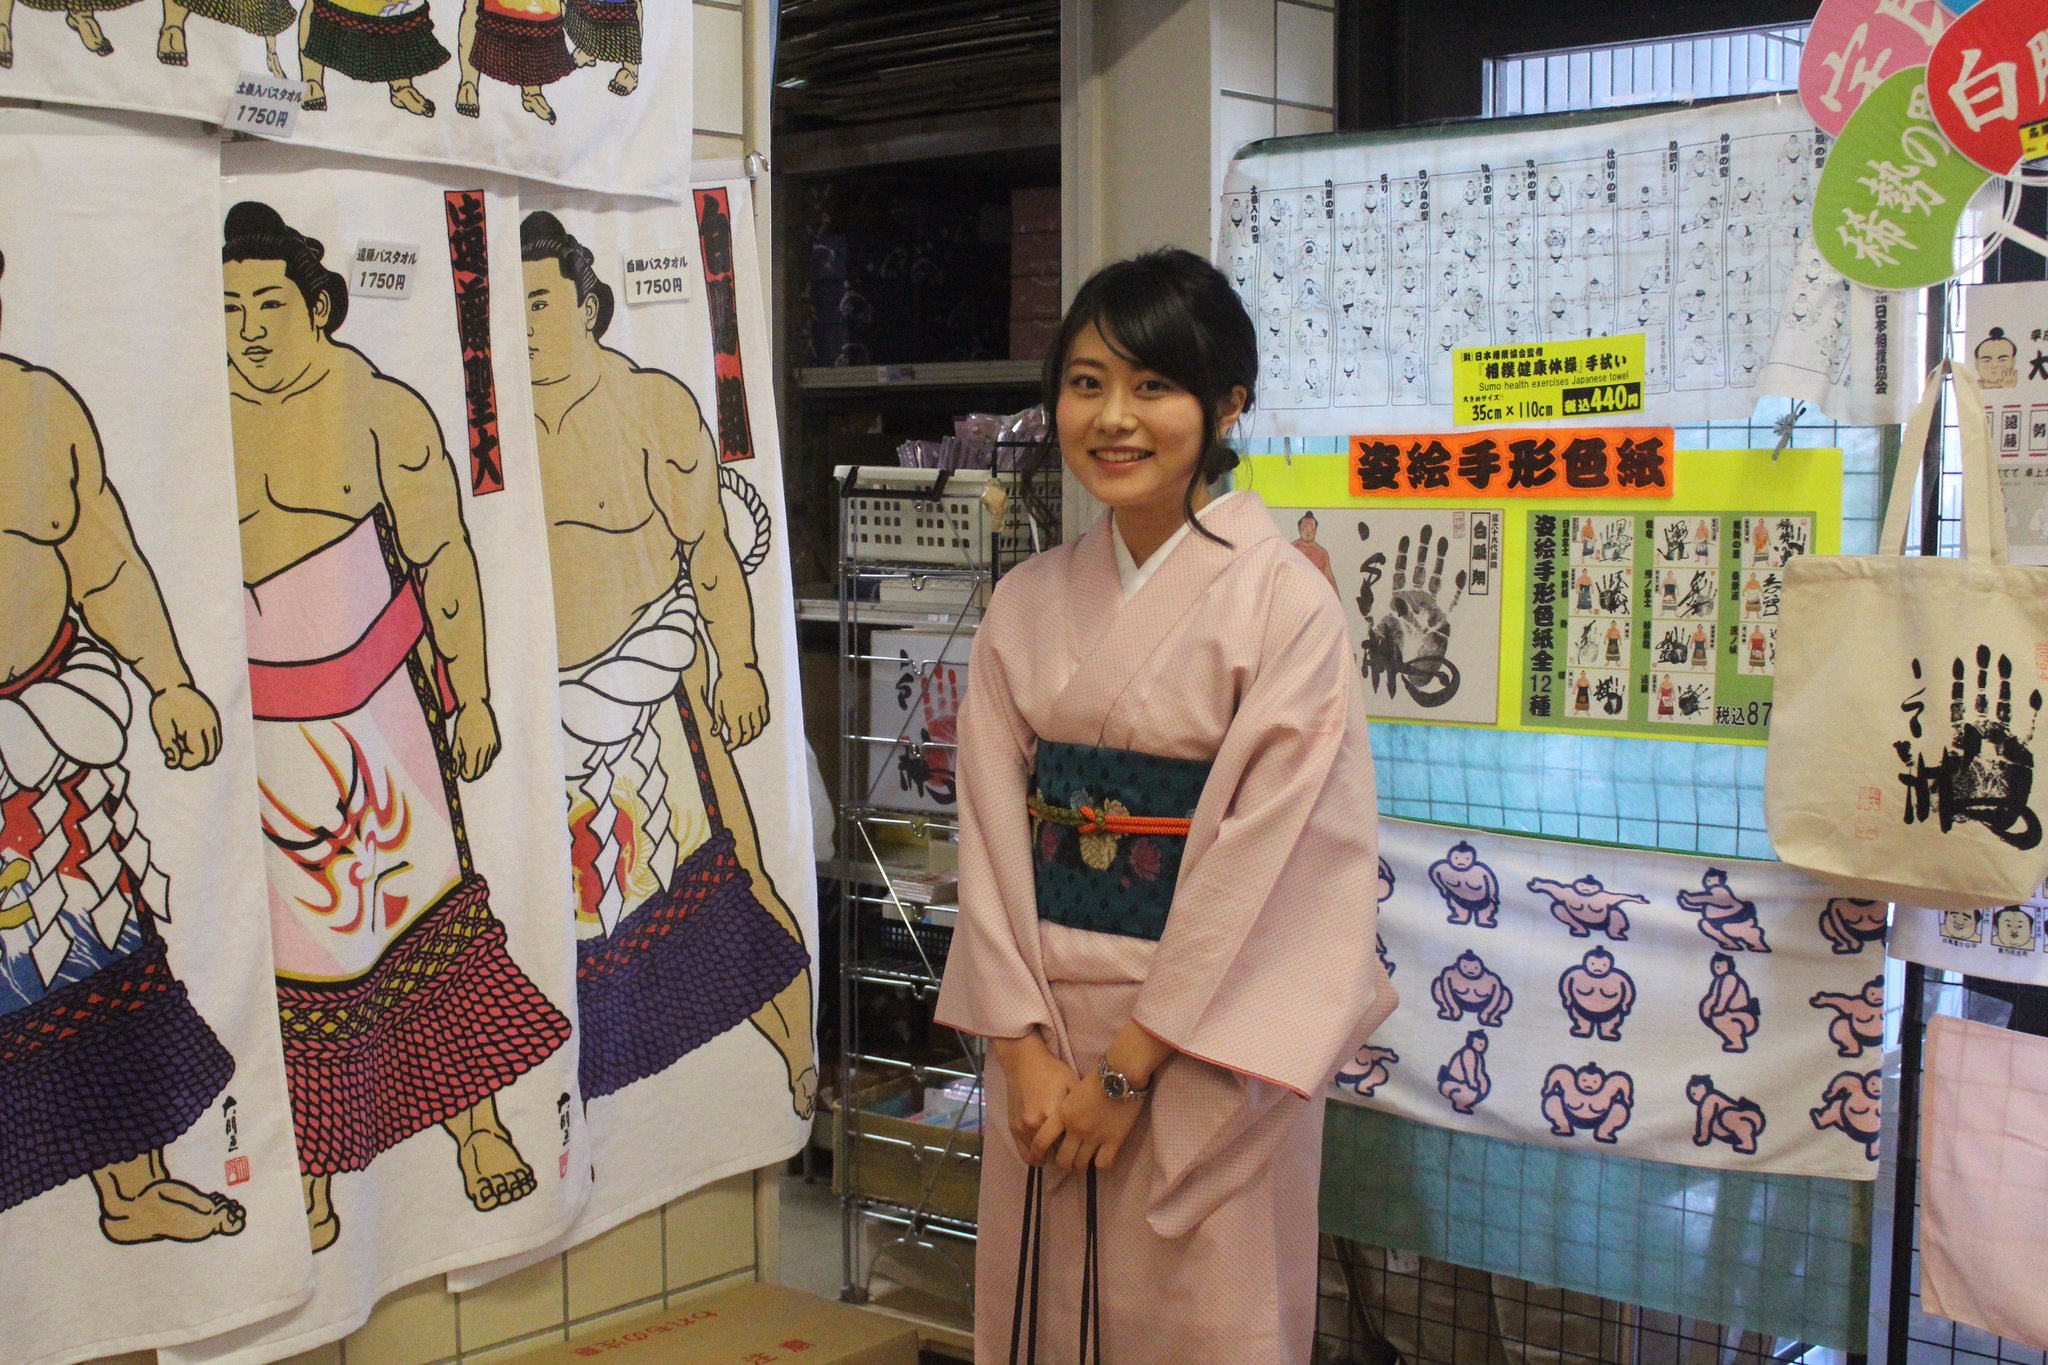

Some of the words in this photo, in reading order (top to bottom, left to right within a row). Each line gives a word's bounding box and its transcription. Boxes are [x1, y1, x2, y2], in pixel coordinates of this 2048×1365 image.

[237, 105, 289, 128] 1750円
[357, 247, 418, 265] 遠藤バスタオル
[360, 271, 406, 291] 1750円
[635, 277, 683, 296] 1750円
[1479, 382, 1502, 391] Sumo
[1504, 380, 1529, 389] health
[1532, 377, 1569, 388] exercises
[1572, 374, 1607, 386] Japanese
[1609, 372, 1629, 382] towel
[1563, 384, 1639, 413] 税込440円
[1472, 403, 1502, 421] 35cm
[1519, 401, 1553, 418] 110cm
[1357, 437, 1666, 490] 姿絵手形色紙
[1529, 514, 1556, 717] 姿絵手形色紙全12種
